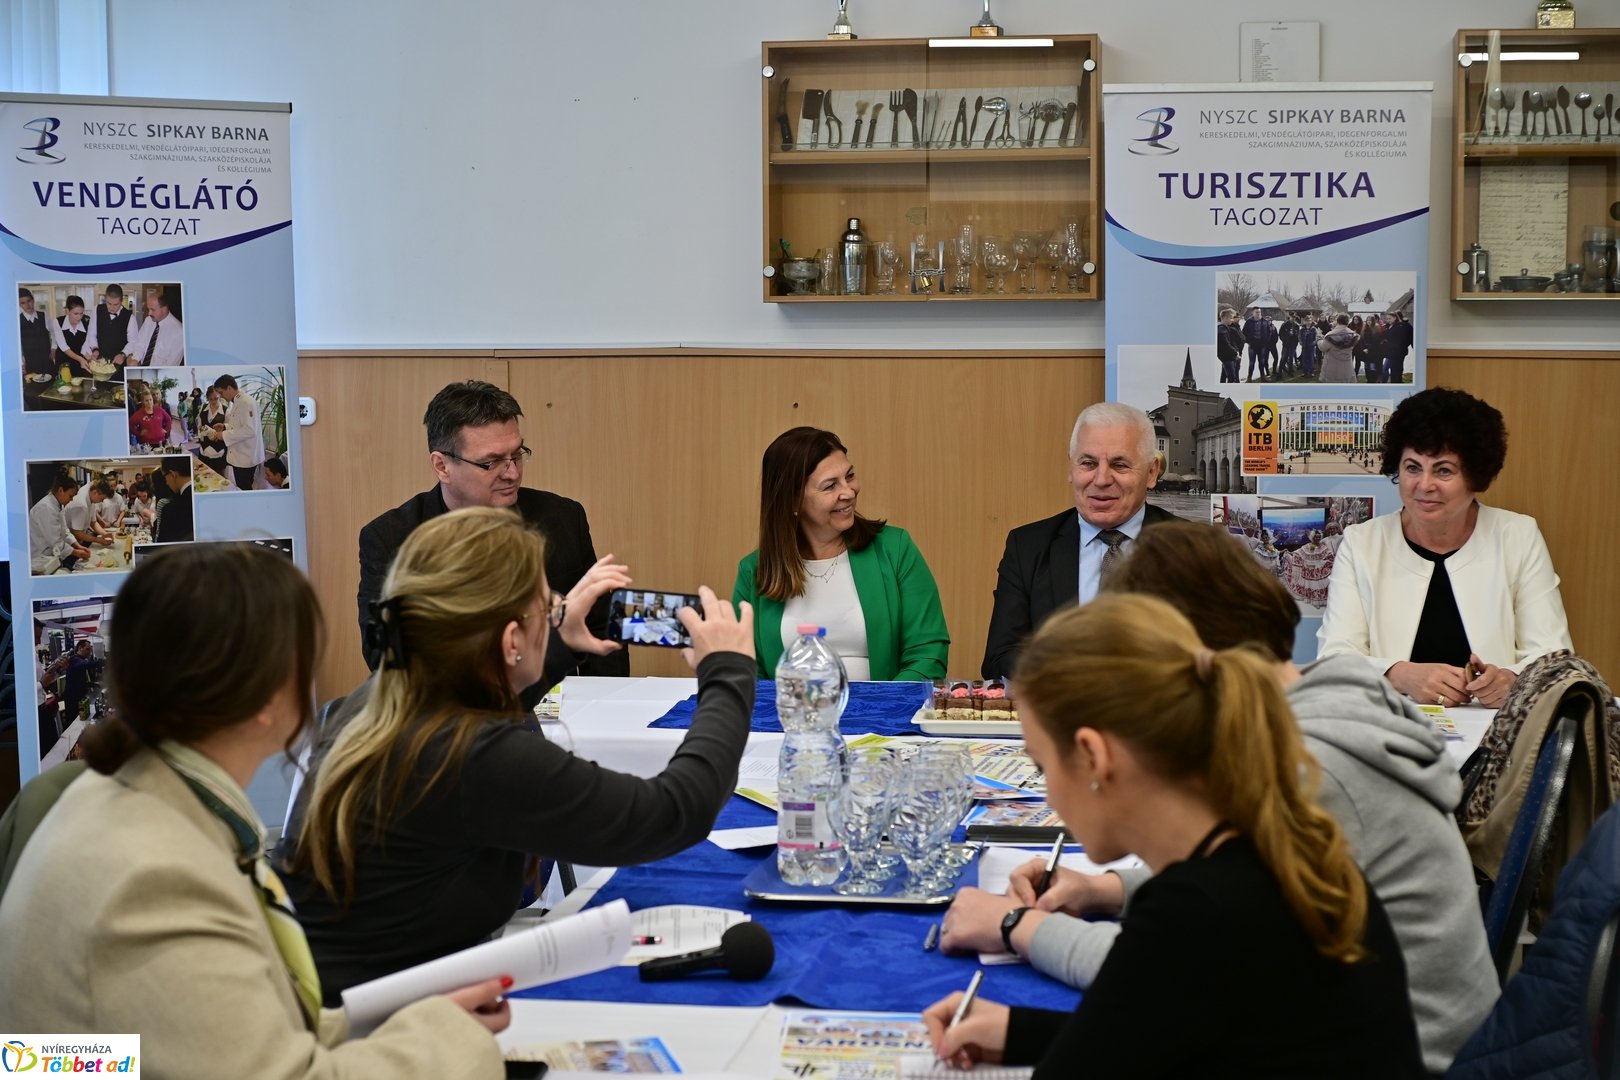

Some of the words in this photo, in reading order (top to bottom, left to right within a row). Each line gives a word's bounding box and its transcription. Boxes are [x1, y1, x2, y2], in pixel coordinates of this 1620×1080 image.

[1200, 109, 1258, 125] NYSZC
[1268, 109, 1334, 124] SIPKAY
[1340, 108, 1406, 123] BARNA
[83, 121, 138, 138] NYSZC
[146, 123, 206, 140] SIPKAY
[211, 125, 269, 141] BARNA
[1199, 131, 1260, 139] KERESKEDELMI,
[1261, 130, 1336, 139] VENDÉGLÁTÓIPARI,
[1337, 130, 1407, 138] IDEGENFORGALMI
[83, 142, 140, 152] KERESKEDELMI,
[210, 146, 271, 155] IDEGENFORGALMI
[1248, 140, 1323, 149] SZAKGIMNÁZIUMA,
[1344, 149, 1354, 158] ÉS
[1355, 149, 1408, 158] KOLLÉGIUMA
[217, 164, 226, 173] ÉS
[227, 165, 272, 174] KOLLÉGIUMA
[1158, 171, 1376, 200] TURISZTIKA
[32, 176, 258, 212] VENDÉGLÁTÓ
[1209, 207, 1323, 226] TAGOZAT
[97, 216, 201, 236] TAGOZAT
[1248, 433, 1273, 445] ITB
